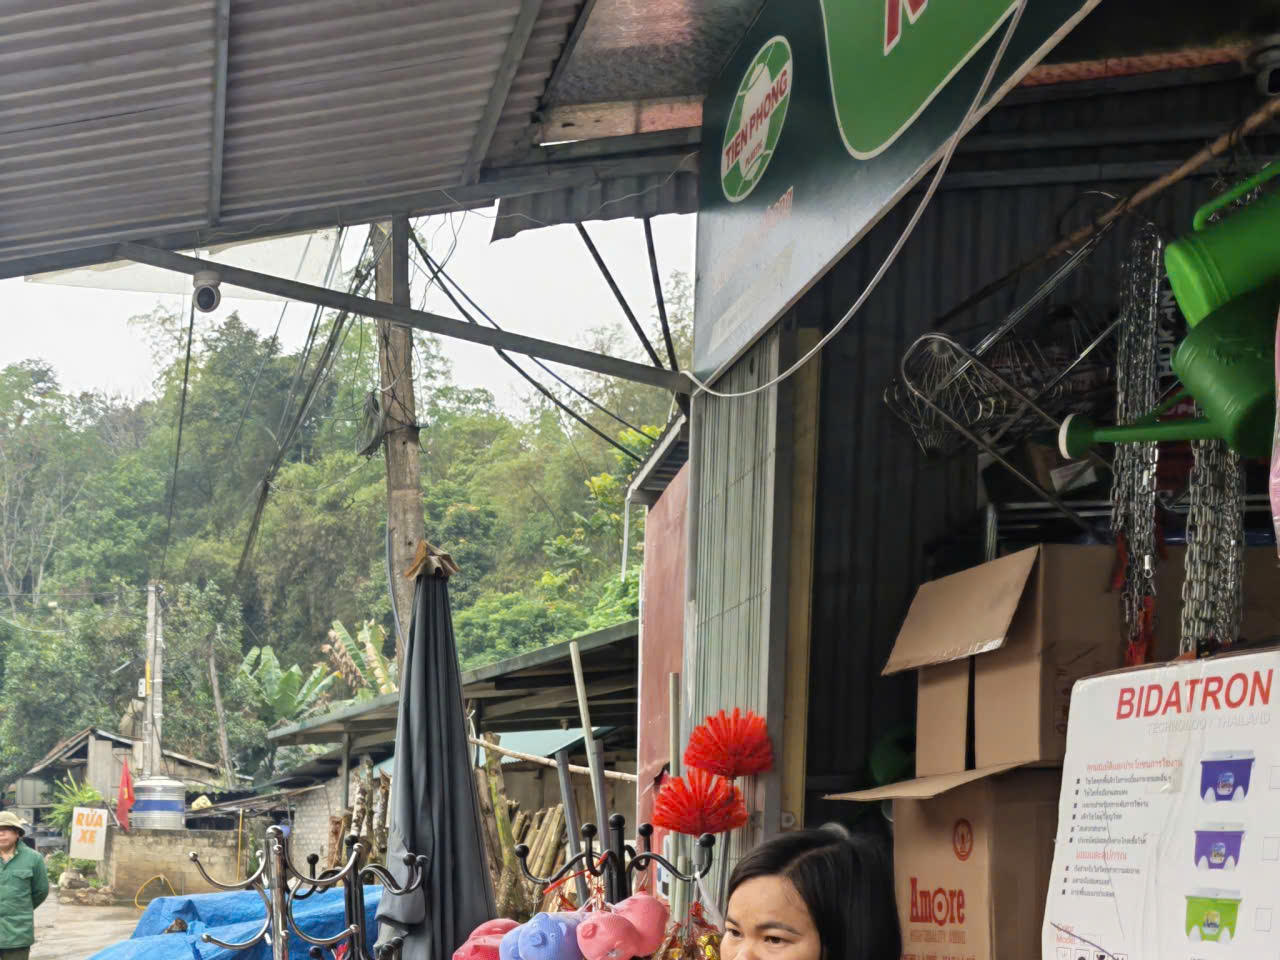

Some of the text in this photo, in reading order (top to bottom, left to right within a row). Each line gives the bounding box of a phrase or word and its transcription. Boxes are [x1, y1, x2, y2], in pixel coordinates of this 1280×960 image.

[725, 68, 788, 171] TIEN PHONG
[1116, 668, 1273, 720] BIDATRON
[78, 830, 96, 844] XE
[909, 877, 965, 926] Amore
